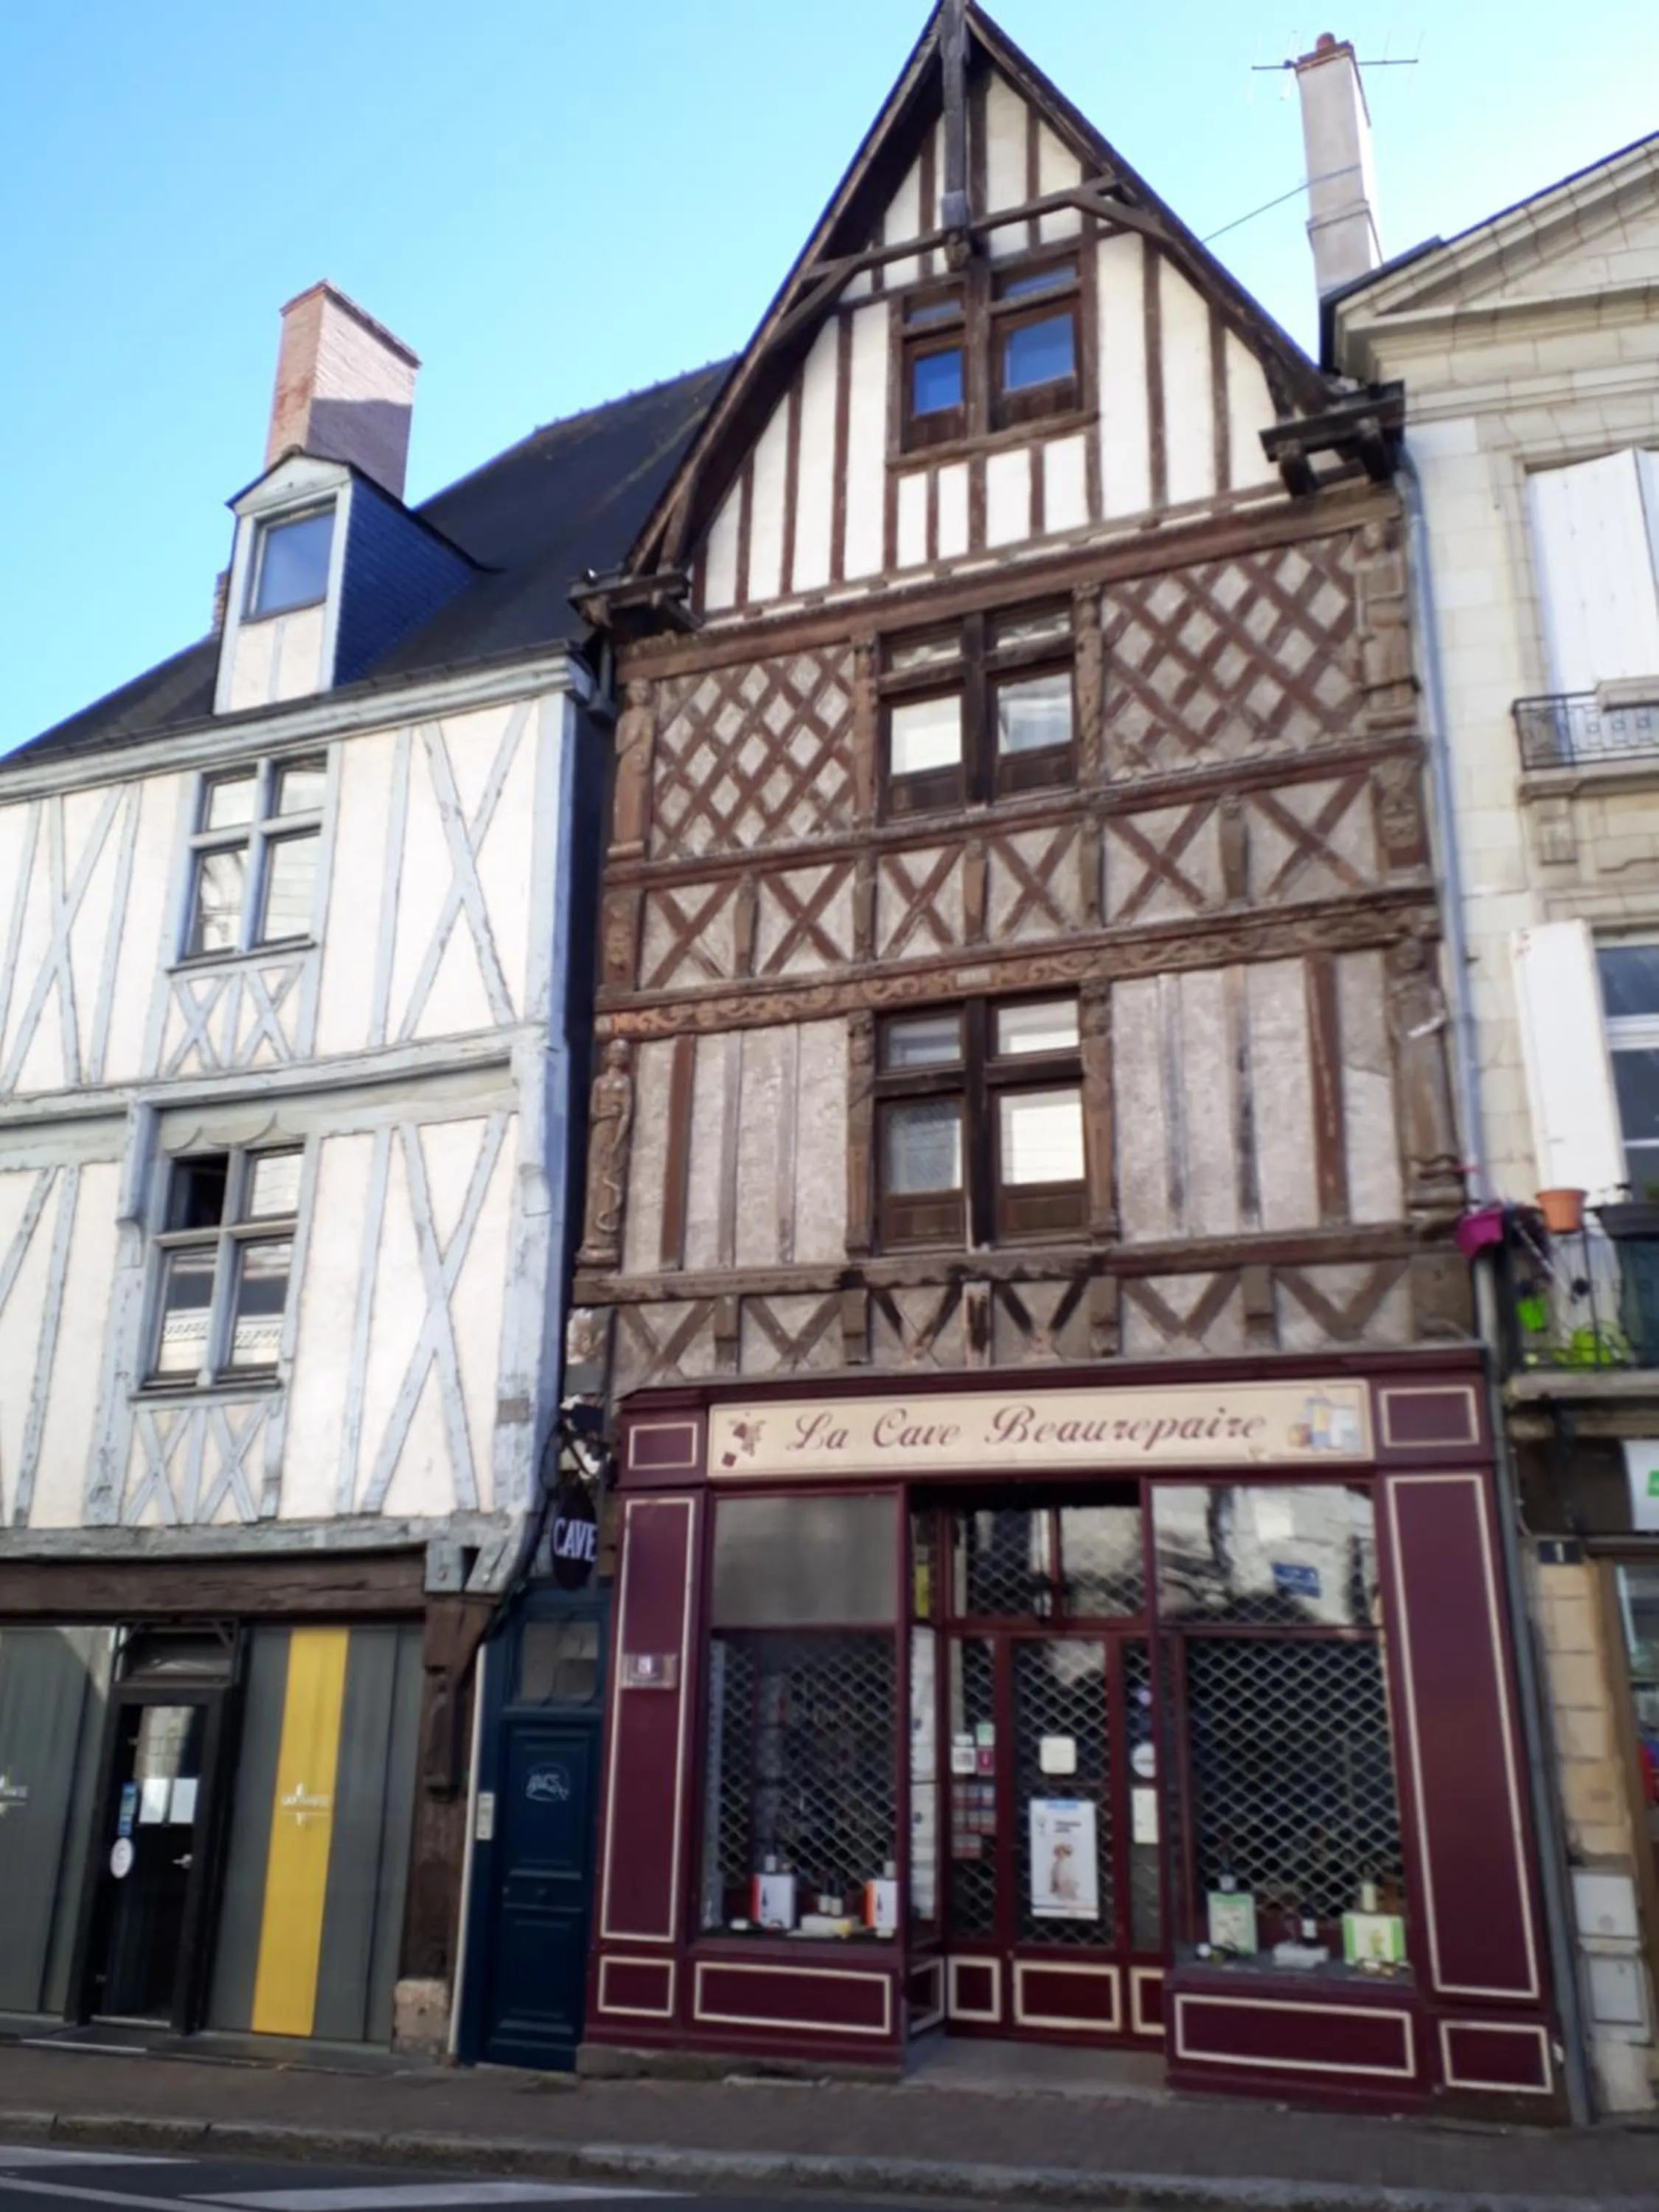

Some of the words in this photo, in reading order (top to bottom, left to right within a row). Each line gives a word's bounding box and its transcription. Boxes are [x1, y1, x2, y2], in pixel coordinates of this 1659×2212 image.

[785, 1411, 849, 1450] La
[872, 1407, 961, 1448] Cave
[984, 1404, 1267, 1452] Beaurepaire
[553, 1517, 598, 1562] CAVE
